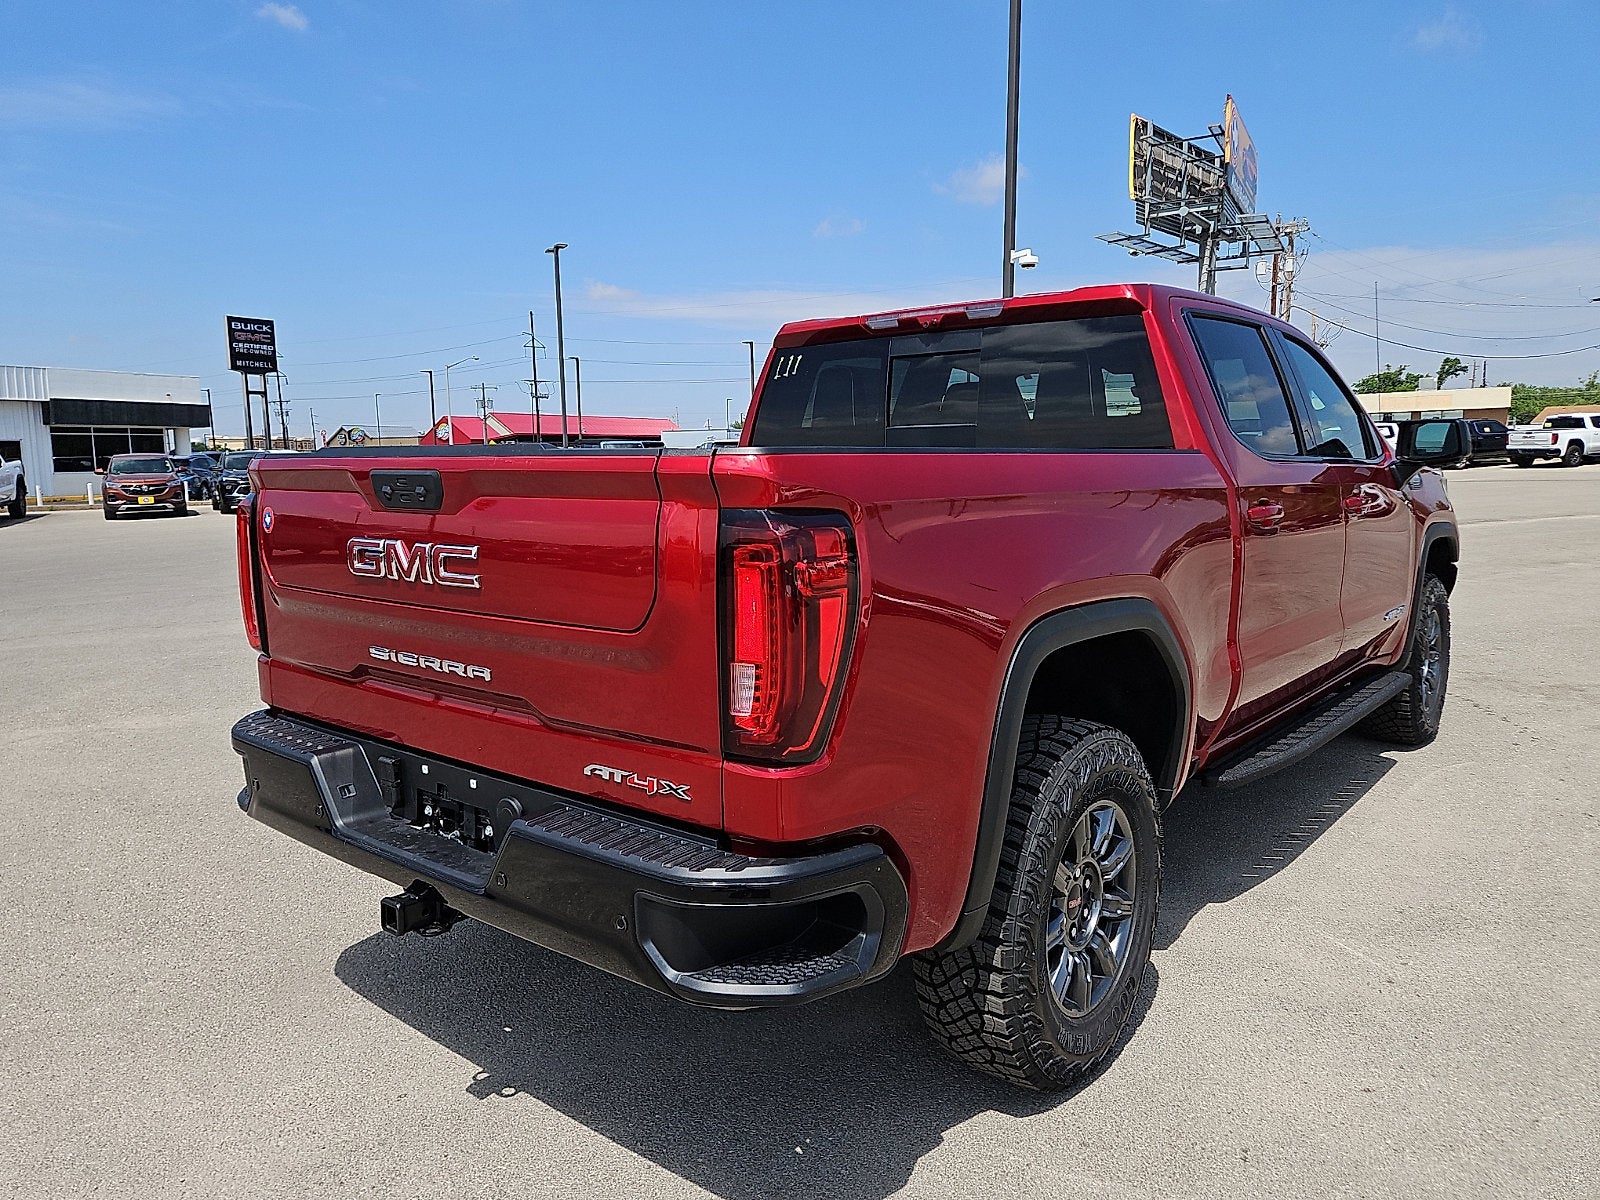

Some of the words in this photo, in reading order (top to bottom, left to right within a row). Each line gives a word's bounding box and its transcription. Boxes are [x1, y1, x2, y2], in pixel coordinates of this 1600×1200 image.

[231, 321, 272, 333] BUICK
[234, 331, 271, 342] GMC
[232, 342, 274, 351] CERTIFIED
[235, 347, 273, 356] PRE-OWNED
[236, 360, 274, 369] MITCHELL
[346, 536, 483, 589] GMC
[368, 645, 492, 682] SIERRA
[583, 762, 693, 801] AT4X
